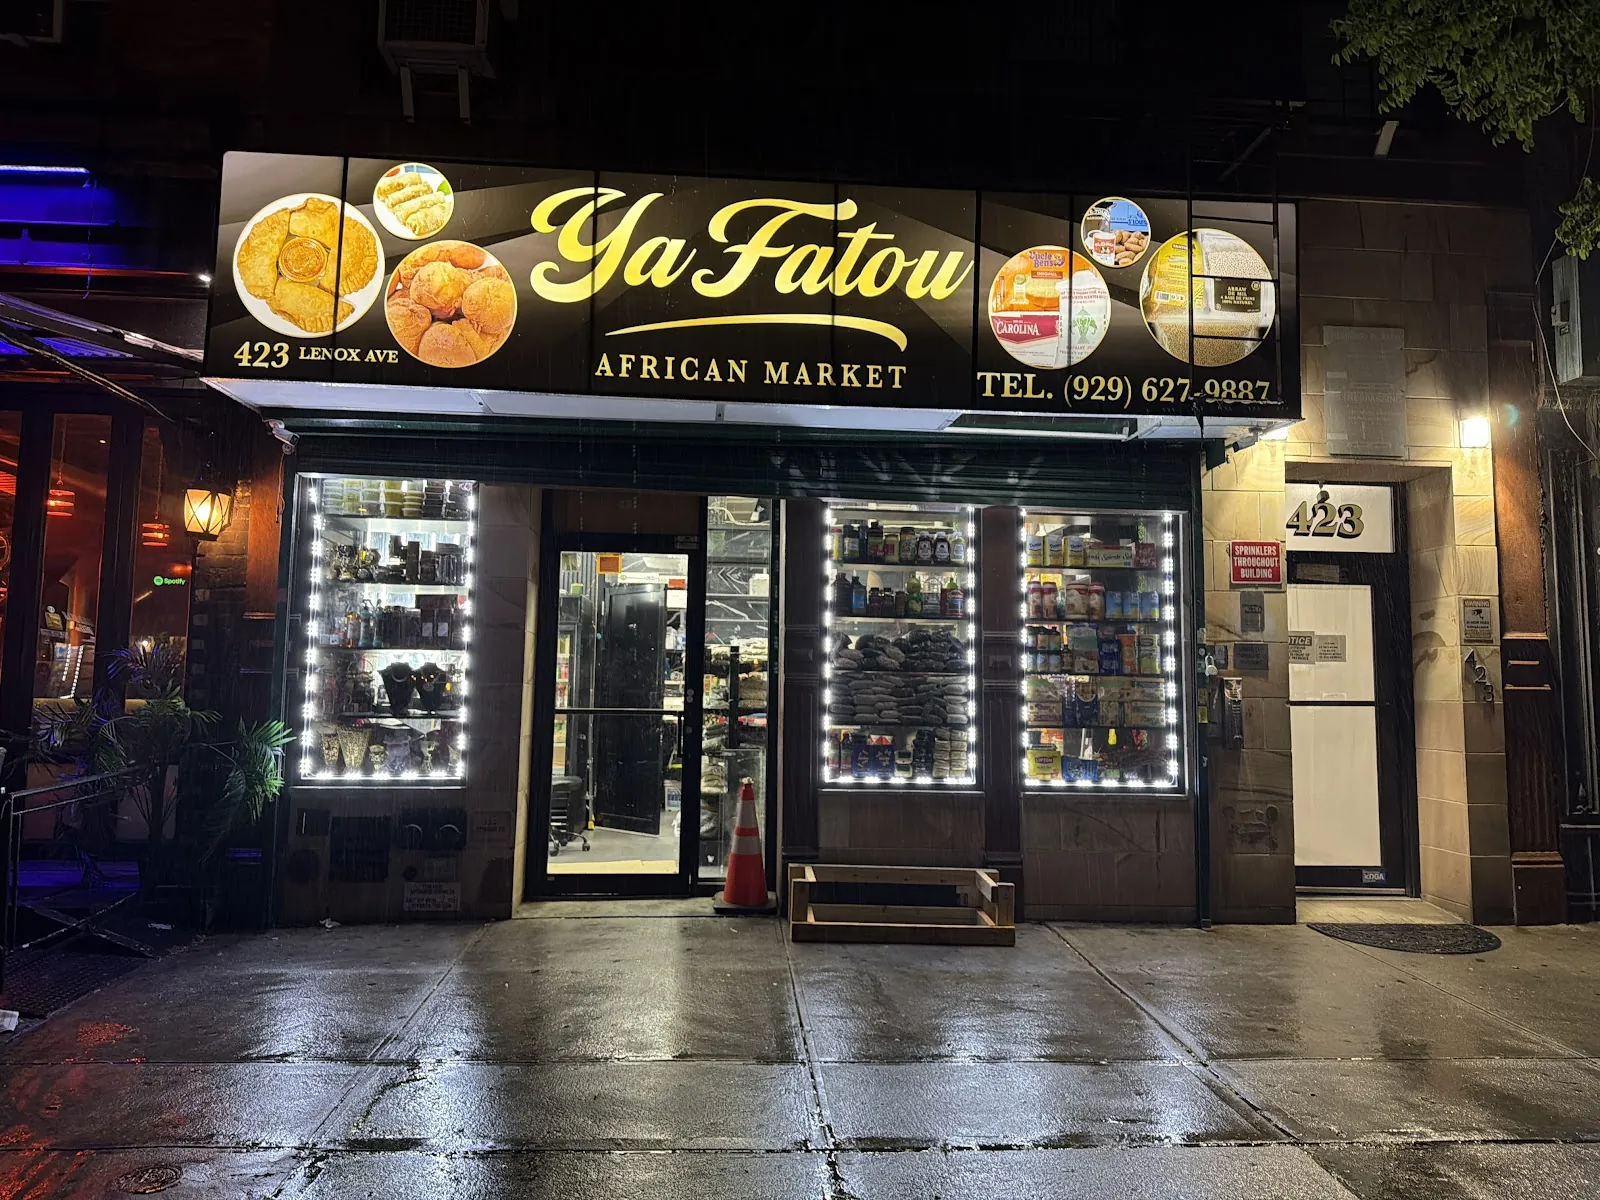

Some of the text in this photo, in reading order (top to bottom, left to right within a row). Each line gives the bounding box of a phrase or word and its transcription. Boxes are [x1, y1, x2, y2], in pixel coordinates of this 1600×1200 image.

[530, 187, 974, 303] Ya Fatou
[1029, 251, 1052, 260] Uncle
[996, 320, 1040, 336] CAROLINA
[234, 341, 399, 369] 423 LENOX AVE
[594, 353, 908, 390] AFRICAN MARKET
[976, 371, 1053, 400] TEL.
[1063, 374, 1132, 409] (929)
[1286, 500, 1364, 539] 423
[1233, 556, 1279, 567] THROUGHOUT
[1235, 545, 1277, 556] SPRINKLERS
[1240, 568, 1273, 579] BUILDING
[1288, 636, 1312, 645] TICE
[1464, 649, 1494, 703] 423
